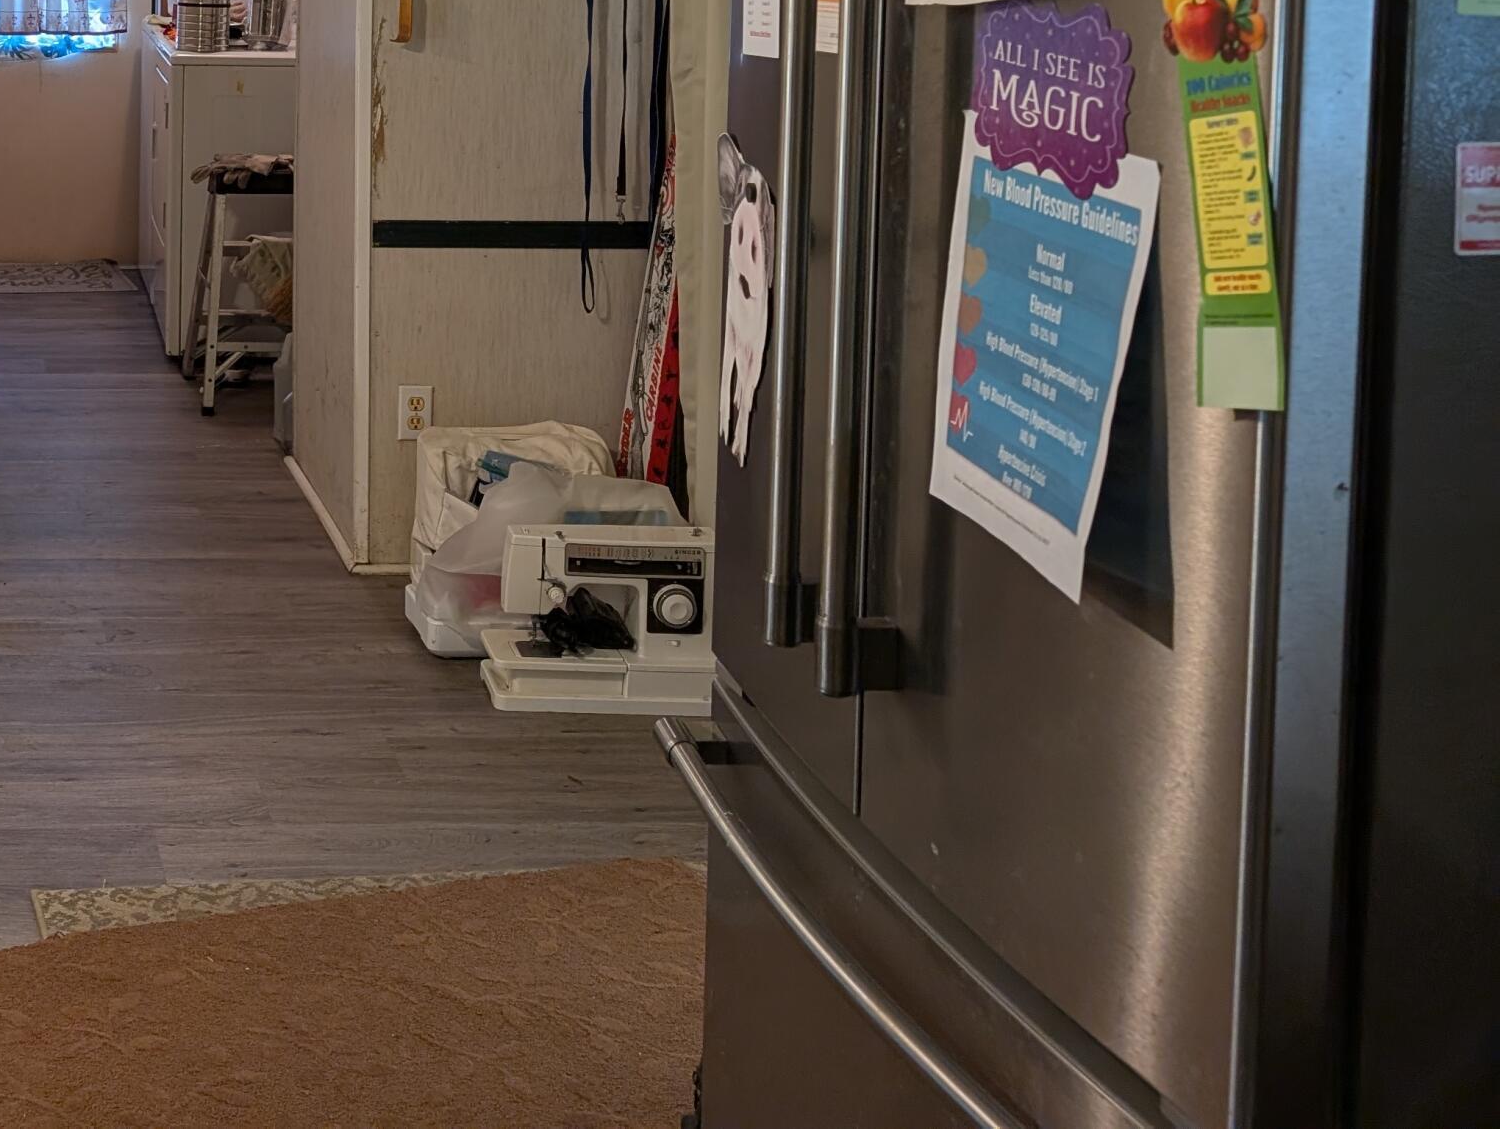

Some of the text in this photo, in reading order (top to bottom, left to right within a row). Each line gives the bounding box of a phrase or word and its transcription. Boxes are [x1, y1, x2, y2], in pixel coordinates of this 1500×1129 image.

[993, 39, 1106, 89] ALL I SEE IS
[989, 69, 1104, 142] MAGIC
[983, 169, 1140, 247] New Blood Pressure Guidelines
[1036, 243, 1066, 272] Normal
[1029, 293, 1062, 325] Elevated
